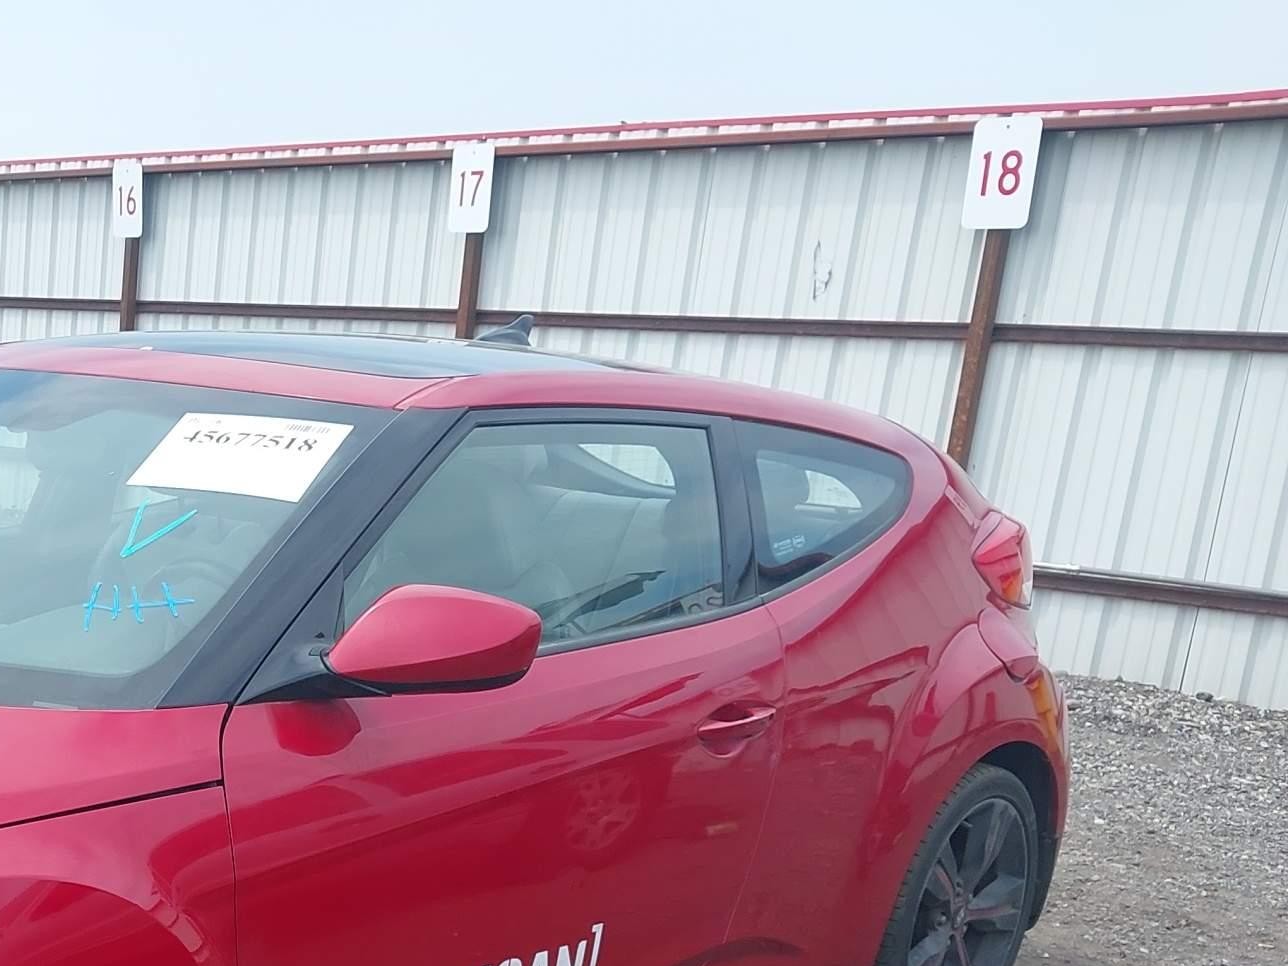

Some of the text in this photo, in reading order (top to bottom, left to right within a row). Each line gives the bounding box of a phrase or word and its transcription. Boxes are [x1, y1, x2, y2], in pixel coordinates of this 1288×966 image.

[459, 170, 485, 207] 17
[980, 149, 1024, 197] 18
[118, 185, 137, 217] 16
[183, 429, 318, 452] 45677518
